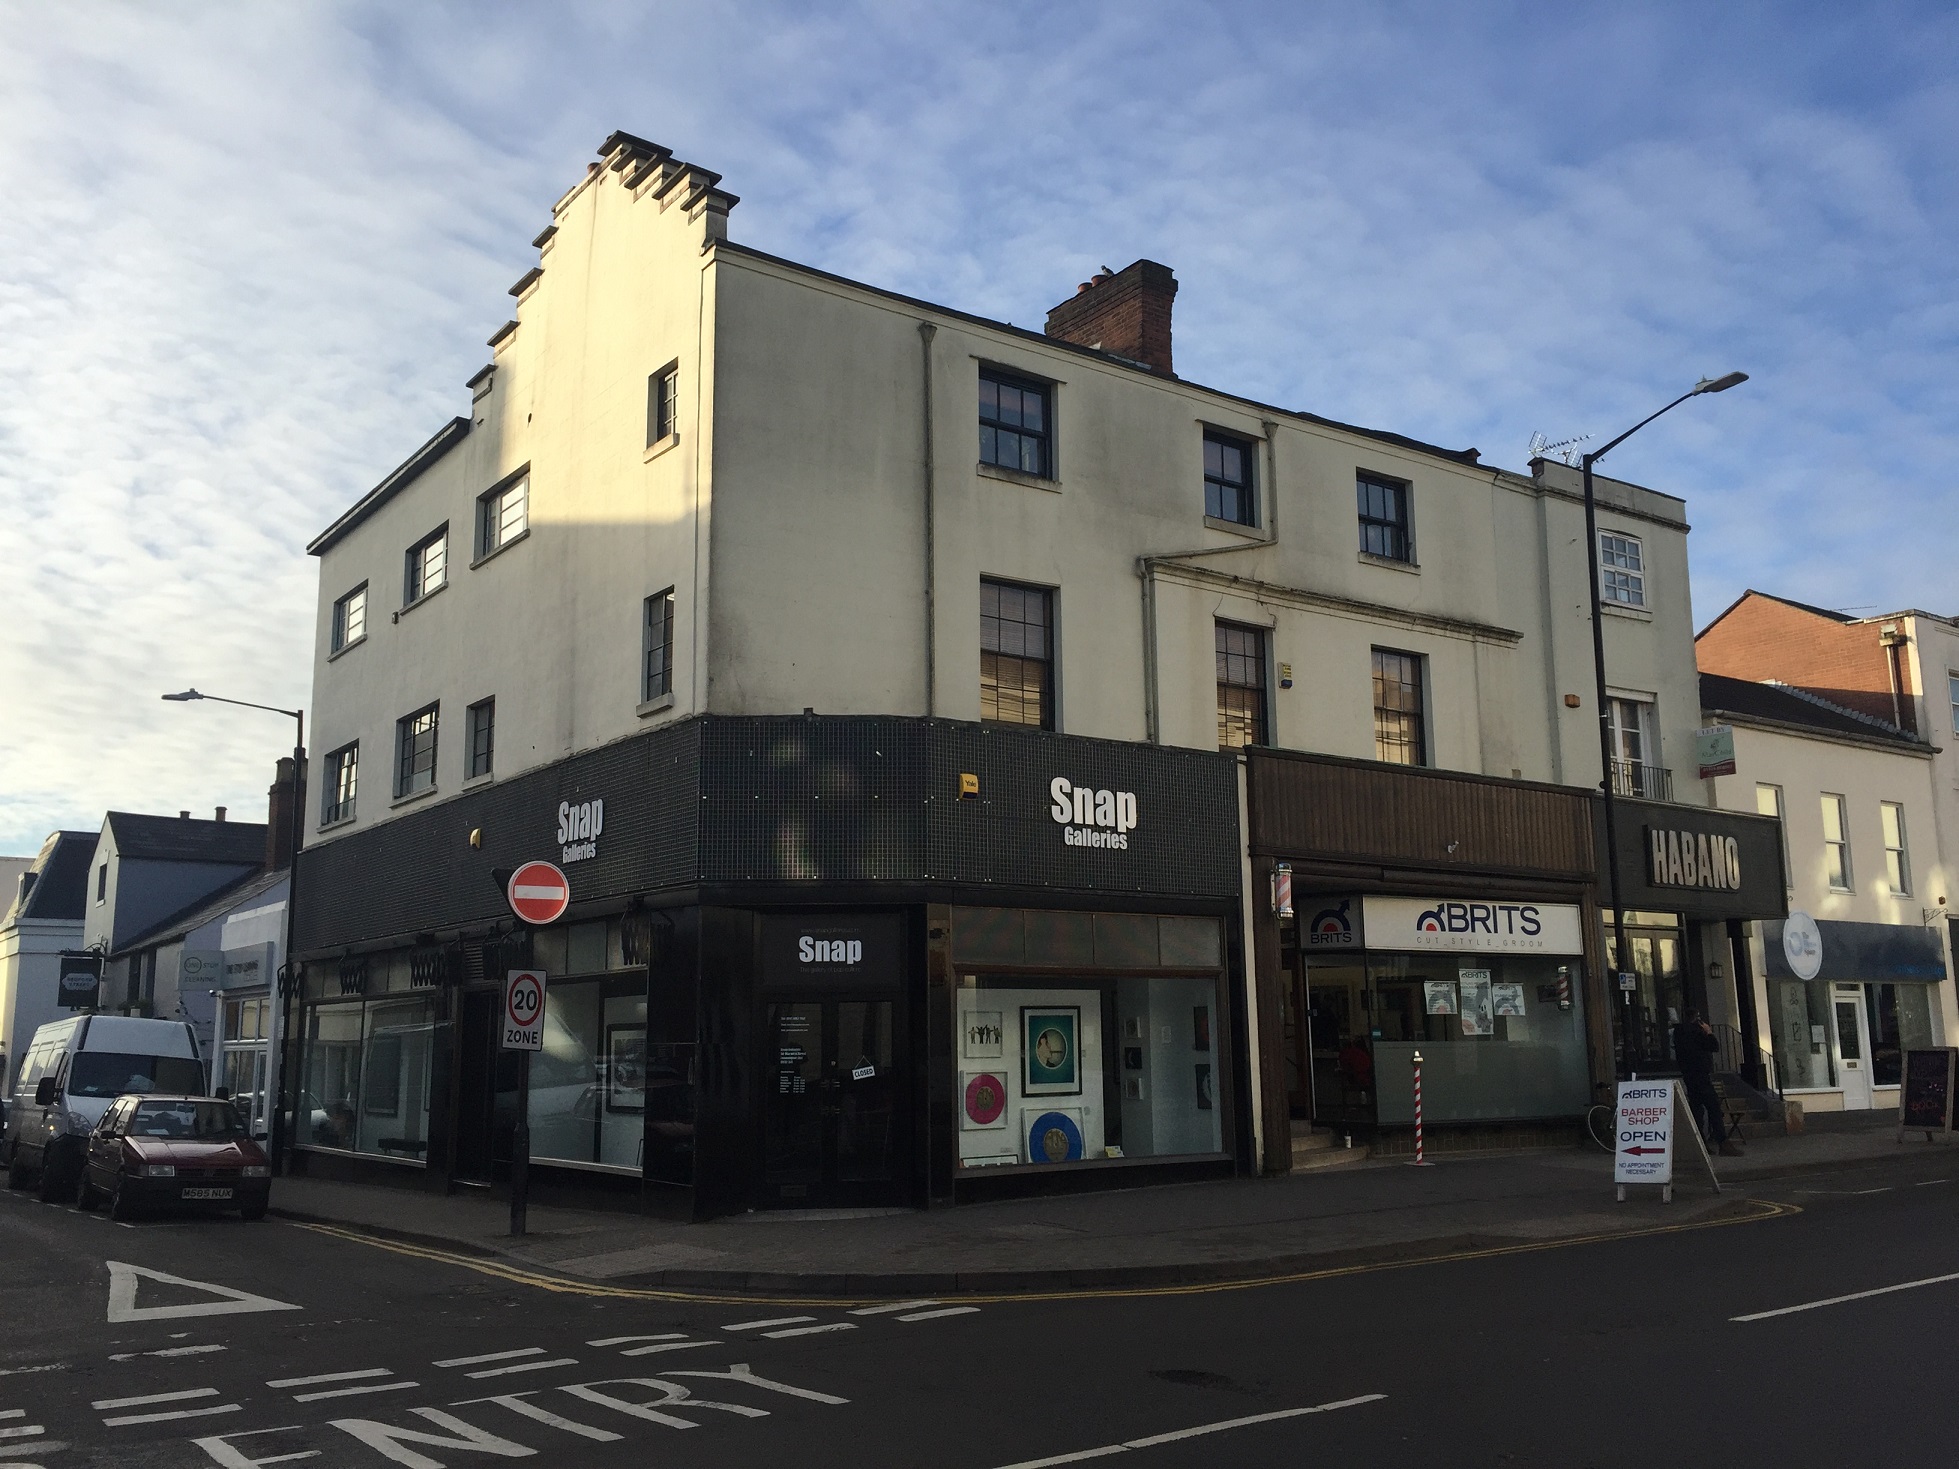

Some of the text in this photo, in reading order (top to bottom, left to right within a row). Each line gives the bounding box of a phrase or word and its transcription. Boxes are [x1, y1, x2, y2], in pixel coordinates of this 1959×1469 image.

[1050, 777, 1138, 832] Snap
[557, 799, 603, 845] Snap
[1064, 826, 1128, 850] Galleries
[562, 842, 596, 864] Galleries
[1651, 829, 1741, 890] HABANO
[1447, 903, 1541, 936] BRITS
[1310, 931, 1352, 944] BRITS
[799, 935, 862, 965] Snap
[514, 990, 538, 1012] 20
[507, 1029, 539, 1045] ZONE
[855, 1068, 873, 1077] CLOSED
[1633, 1089, 1667, 1099] BRITS
[1621, 1107, 1667, 1117] BARBER
[1628, 1117, 1660, 1125] SHOP
[1620, 1131, 1666, 1142] OPEN
[191, 1363, 851, 1469] ENTRY
